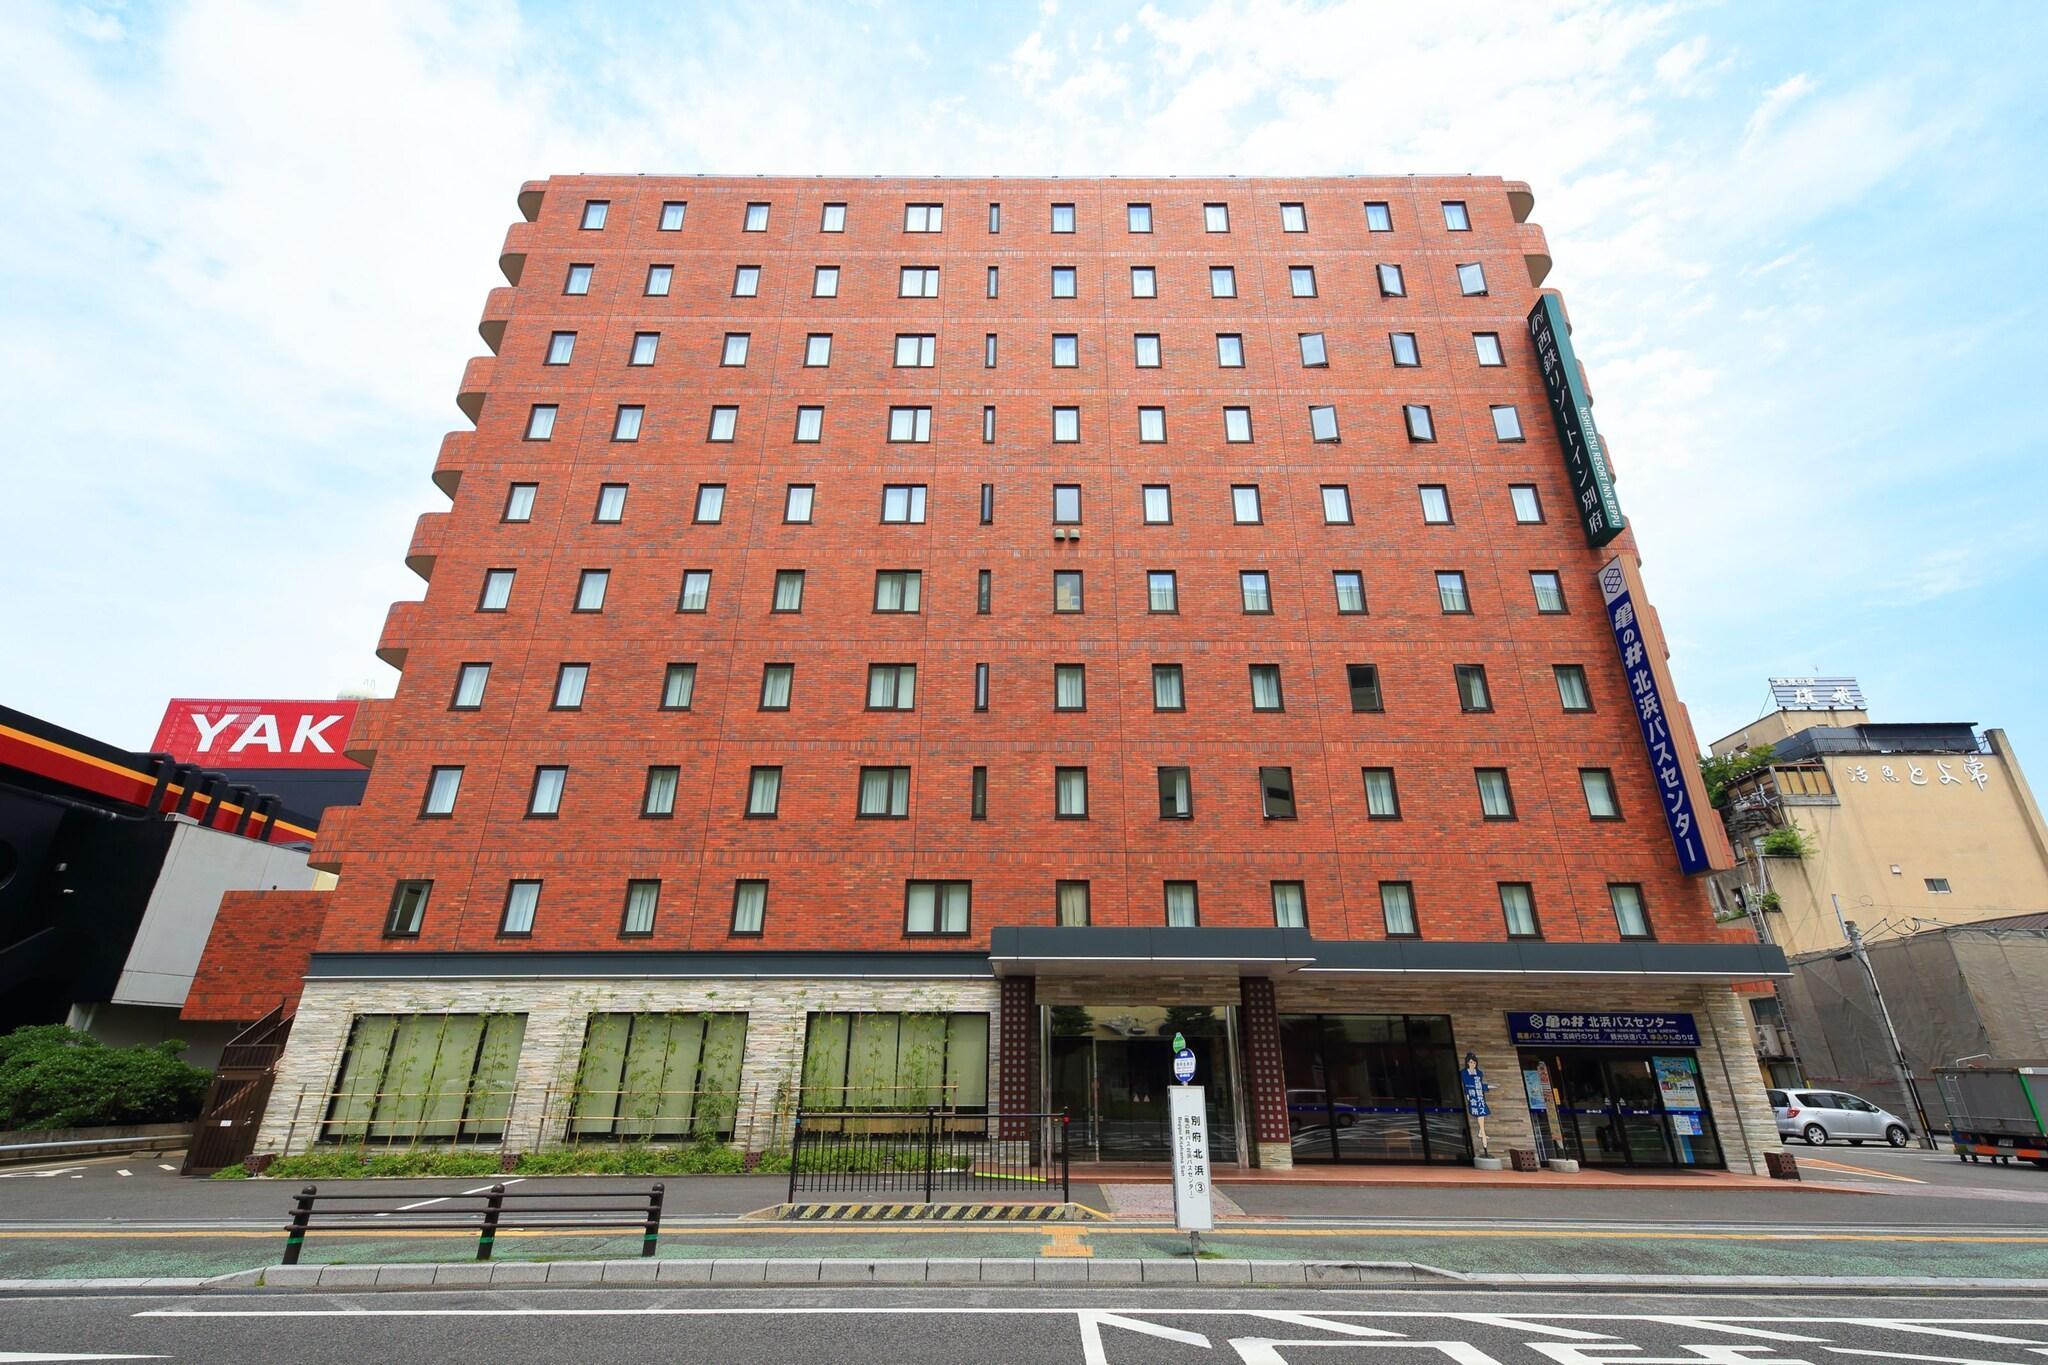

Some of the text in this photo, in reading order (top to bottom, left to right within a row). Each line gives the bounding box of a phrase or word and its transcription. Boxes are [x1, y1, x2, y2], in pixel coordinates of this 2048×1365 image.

[1536, 327, 1603, 536] 西鉄リゾートイン別府
[1579, 406, 1622, 526] NISHITETSU RESORT INN BEPPU
